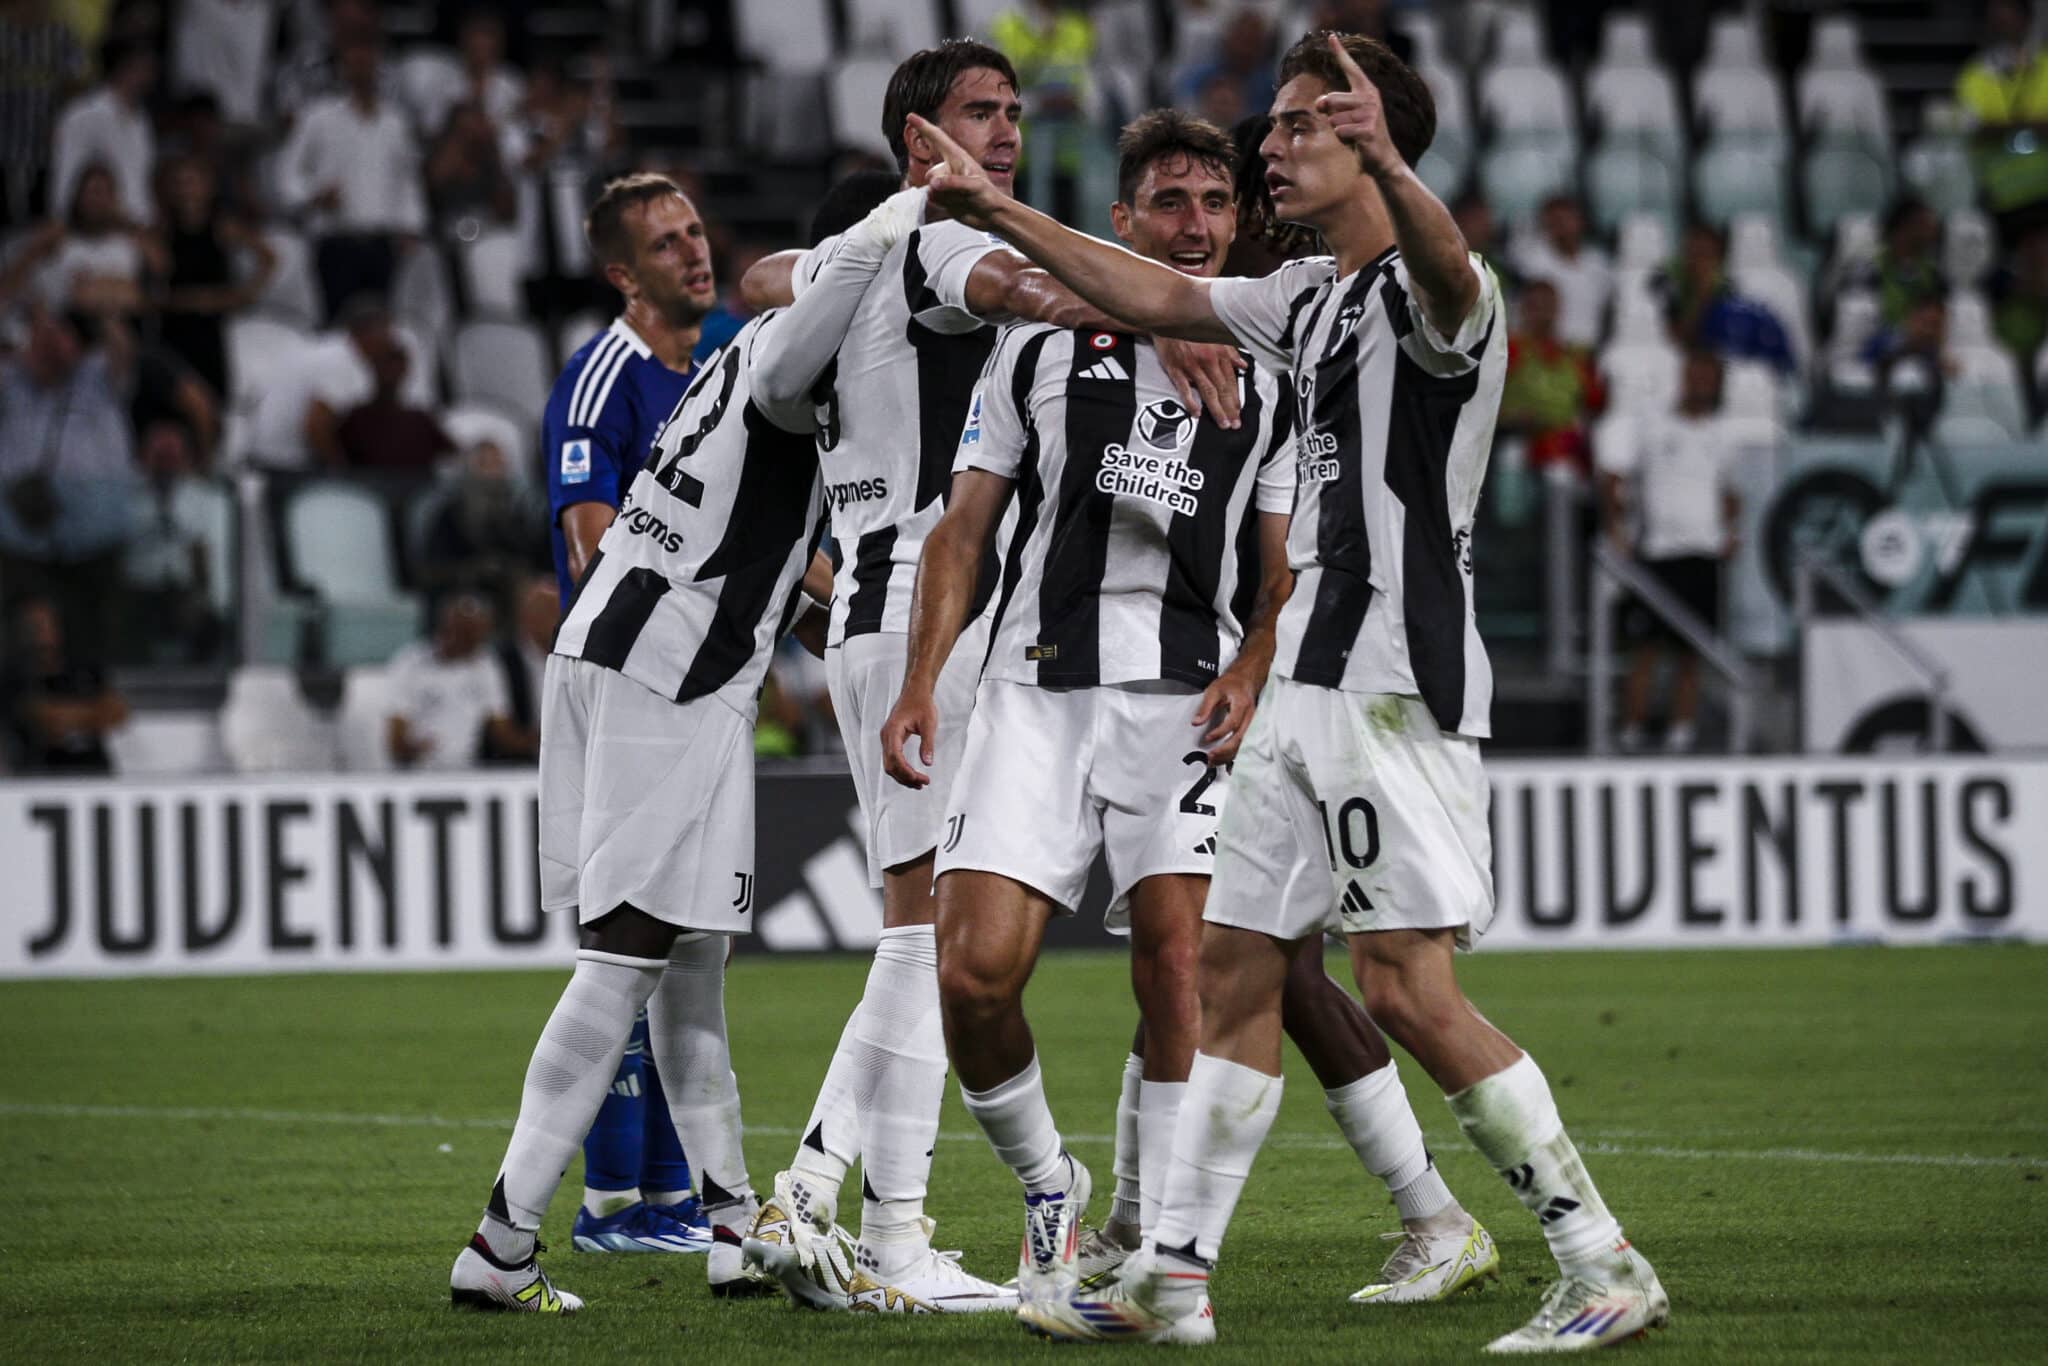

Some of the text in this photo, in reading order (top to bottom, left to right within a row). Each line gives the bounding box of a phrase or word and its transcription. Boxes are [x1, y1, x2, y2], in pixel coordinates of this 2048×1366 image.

[1103, 445, 1202, 487] Save the
[1306, 432, 1336, 454] the
[1098, 470, 1196, 514] Children
[1319, 796, 1391, 870] 10
[1488, 777, 2016, 930] UVENTUS
[26, 797, 580, 958] JUVENTU
